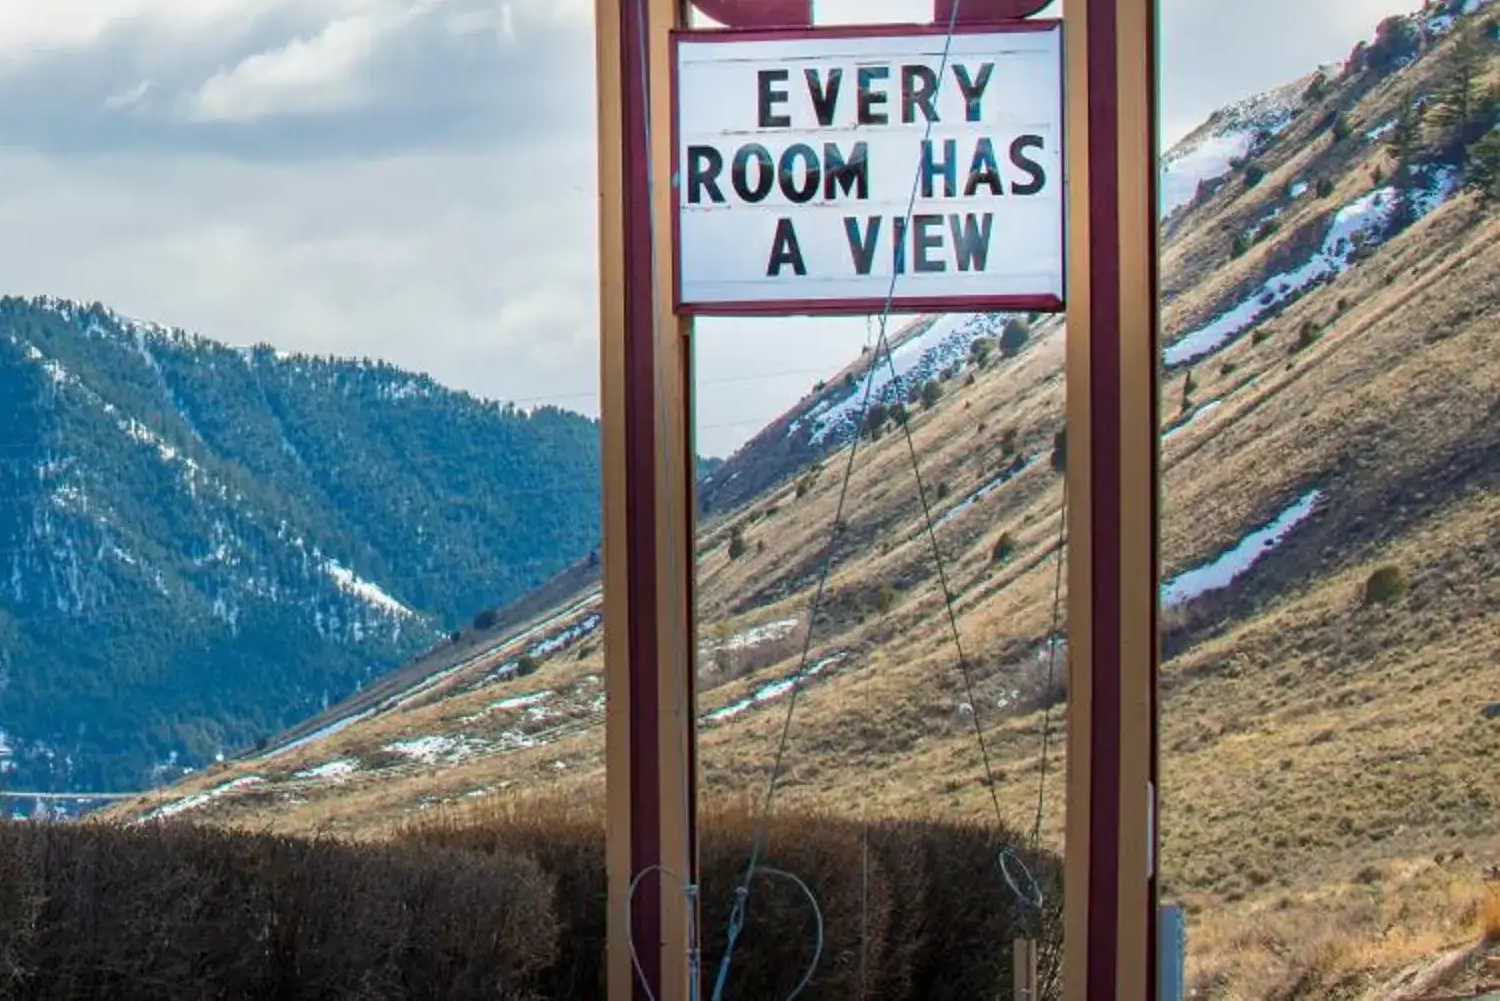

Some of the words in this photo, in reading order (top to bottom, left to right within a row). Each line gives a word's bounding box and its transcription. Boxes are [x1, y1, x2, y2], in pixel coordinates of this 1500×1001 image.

[757, 63, 995, 127] EVERY
[687, 142, 868, 203] ROOM
[921, 135, 1046, 197] HAS
[767, 218, 807, 276] A
[844, 212, 993, 275] VIEW
